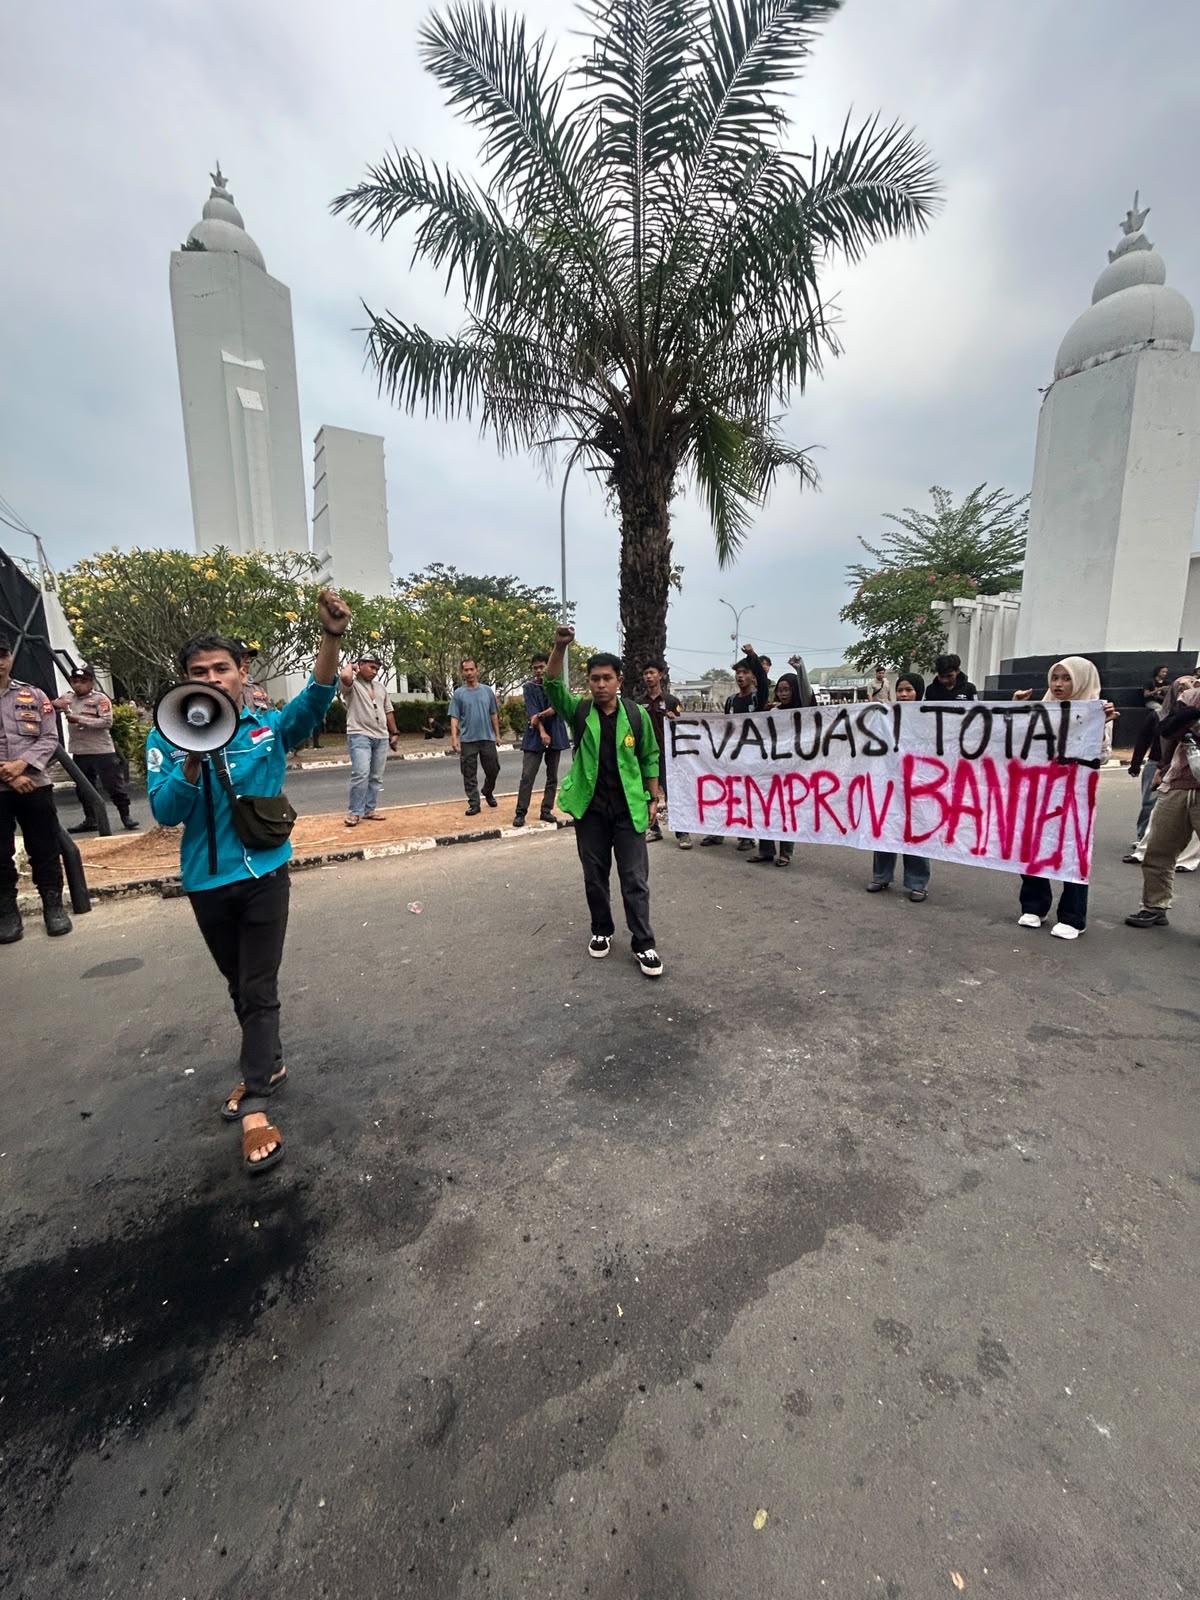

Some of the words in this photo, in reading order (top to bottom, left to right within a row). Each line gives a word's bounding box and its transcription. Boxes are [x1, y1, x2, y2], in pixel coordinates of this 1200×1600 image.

[921, 701, 1100, 769] TOTAL
[697, 771, 894, 839] PEMPROV
[903, 754, 1098, 880] BANTEN
